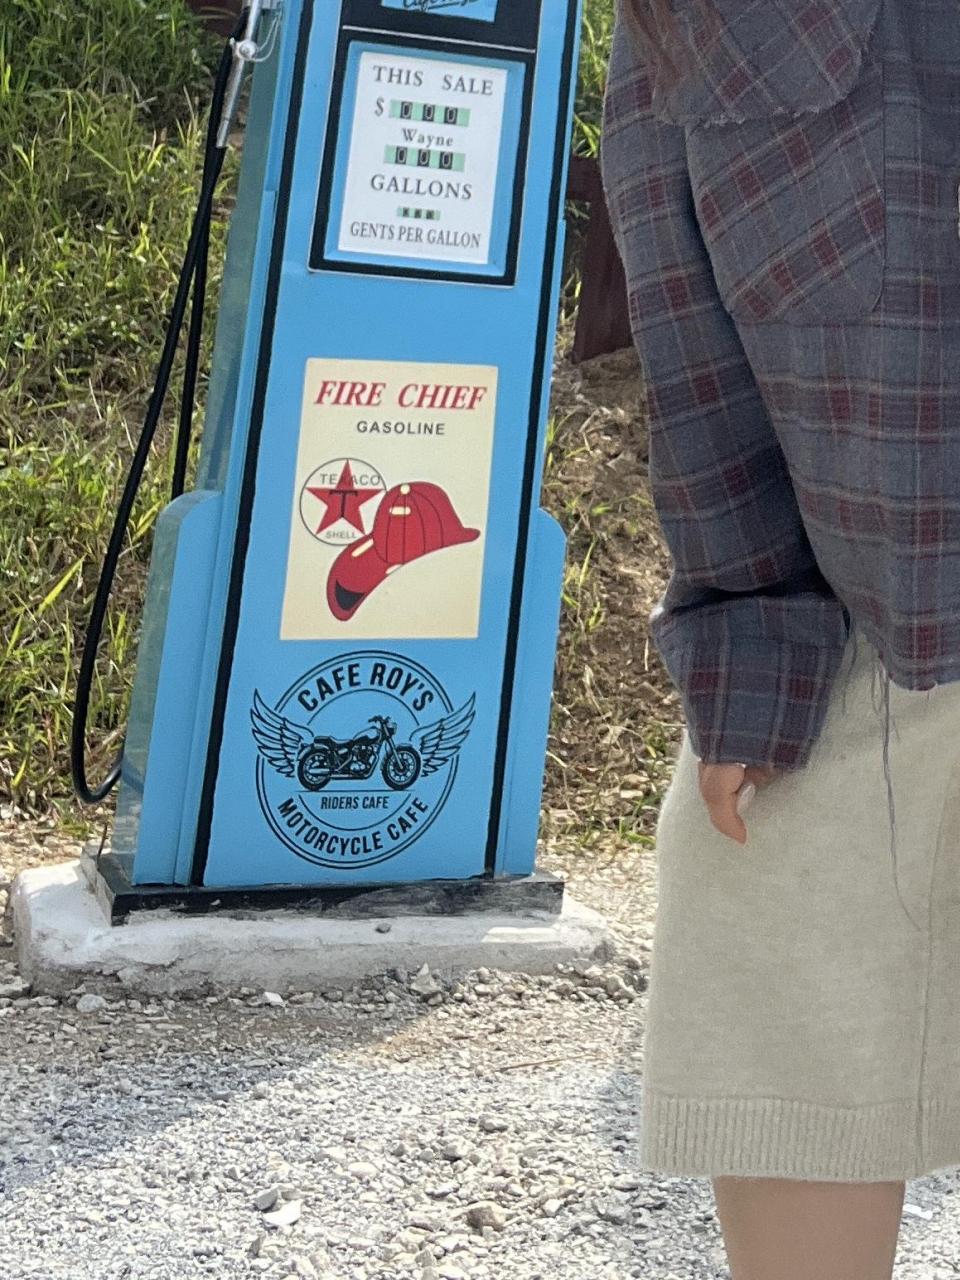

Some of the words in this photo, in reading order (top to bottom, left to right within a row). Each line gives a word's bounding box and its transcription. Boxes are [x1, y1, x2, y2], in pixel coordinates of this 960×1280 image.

[373, 65, 424, 87] THIS
[442, 75, 494, 96] SALE
[402, 127, 454, 148] Wayne
[370, 174, 473, 200] GALLONS
[399, 225, 423, 243] PER
[427, 228, 482, 248] GALLON
[314, 380, 386, 407] FIRE
[398, 383, 487, 410] CHIEF
[356, 420, 446, 435] GASOLINE
[298, 663, 361, 712] CAFE
[370, 662, 434, 712] ROY'S
[320, 795, 359, 810] RIDERS
[362, 796, 390, 810] CAFE
[277, 797, 383, 856] MOTORCYCLE
[387, 796, 429, 841] CAFE
